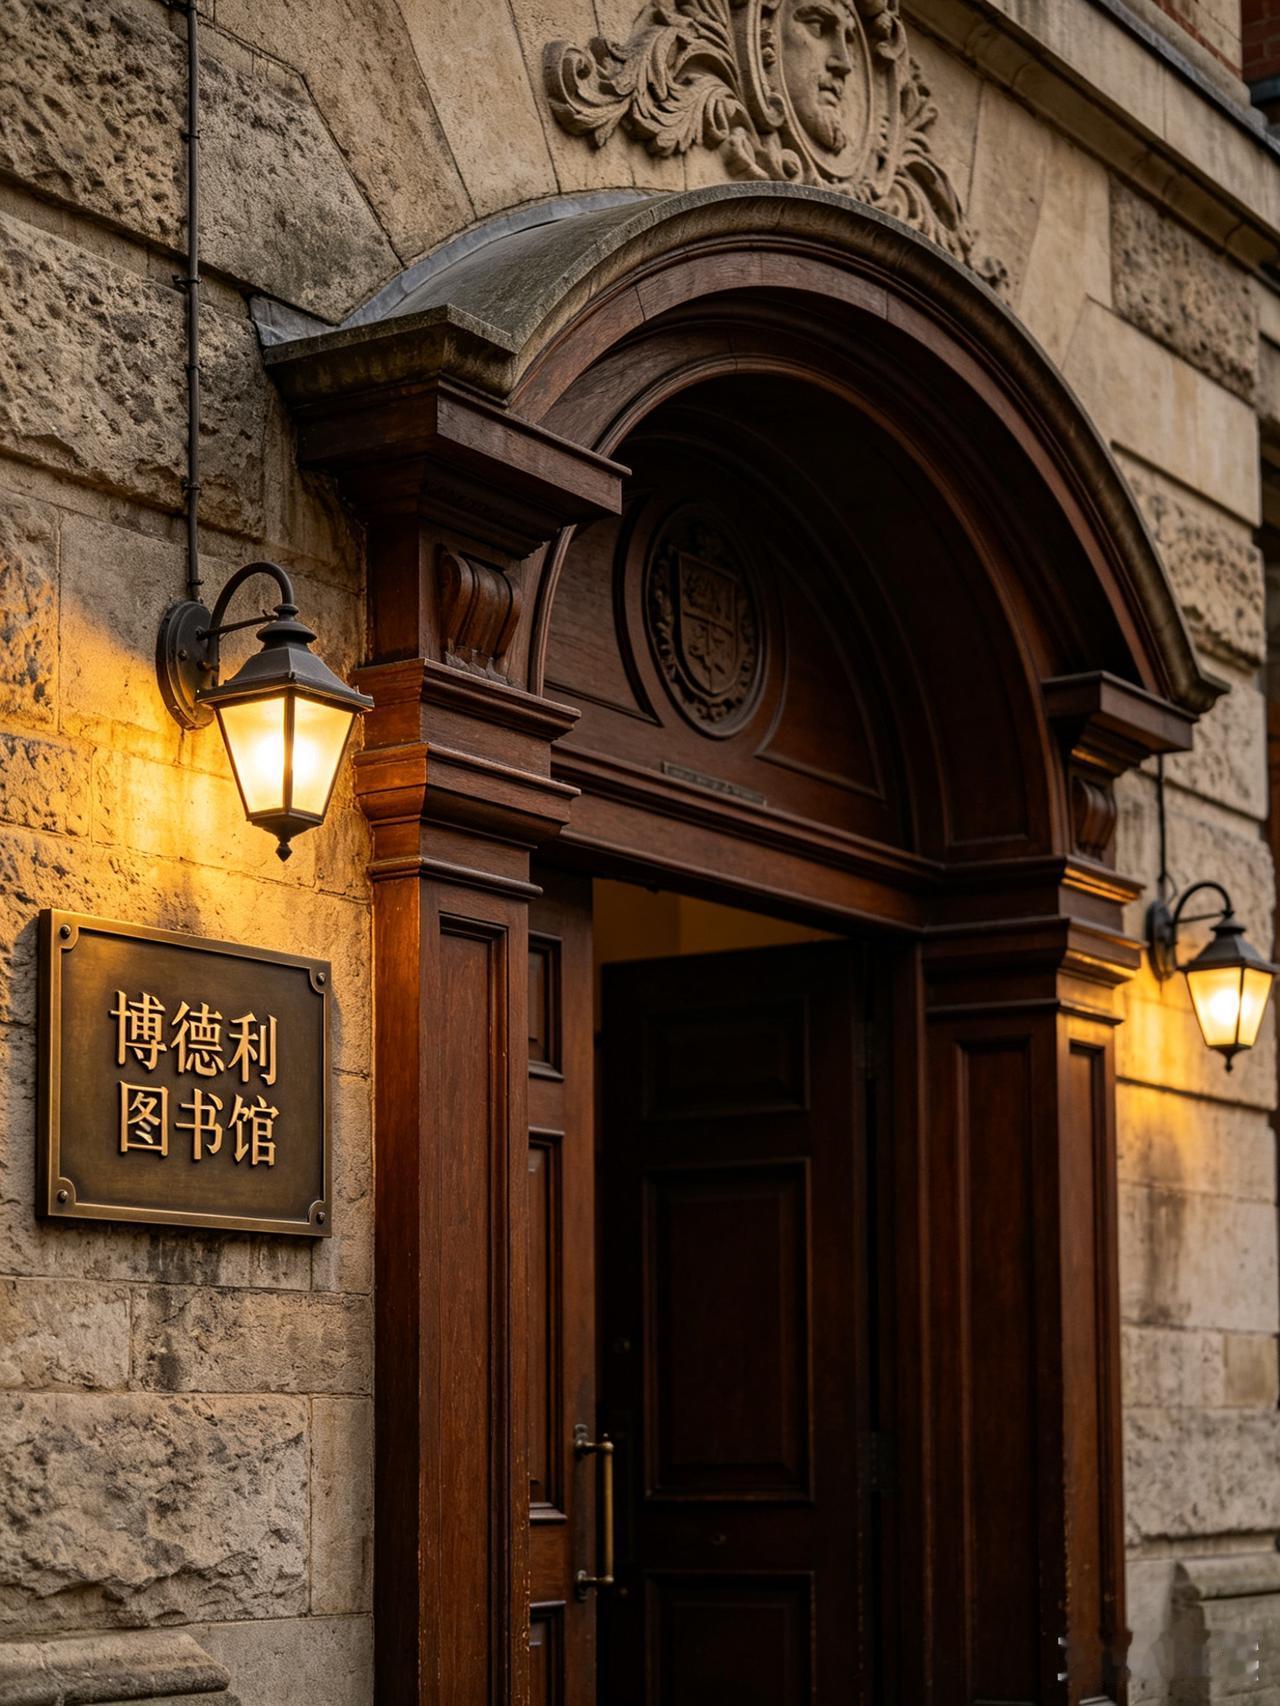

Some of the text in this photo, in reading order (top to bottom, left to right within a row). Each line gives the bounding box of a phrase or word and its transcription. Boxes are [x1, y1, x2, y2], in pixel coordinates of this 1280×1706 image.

[109, 990, 278, 1086] 博德利
[119, 1080, 280, 1167] 图书馆
